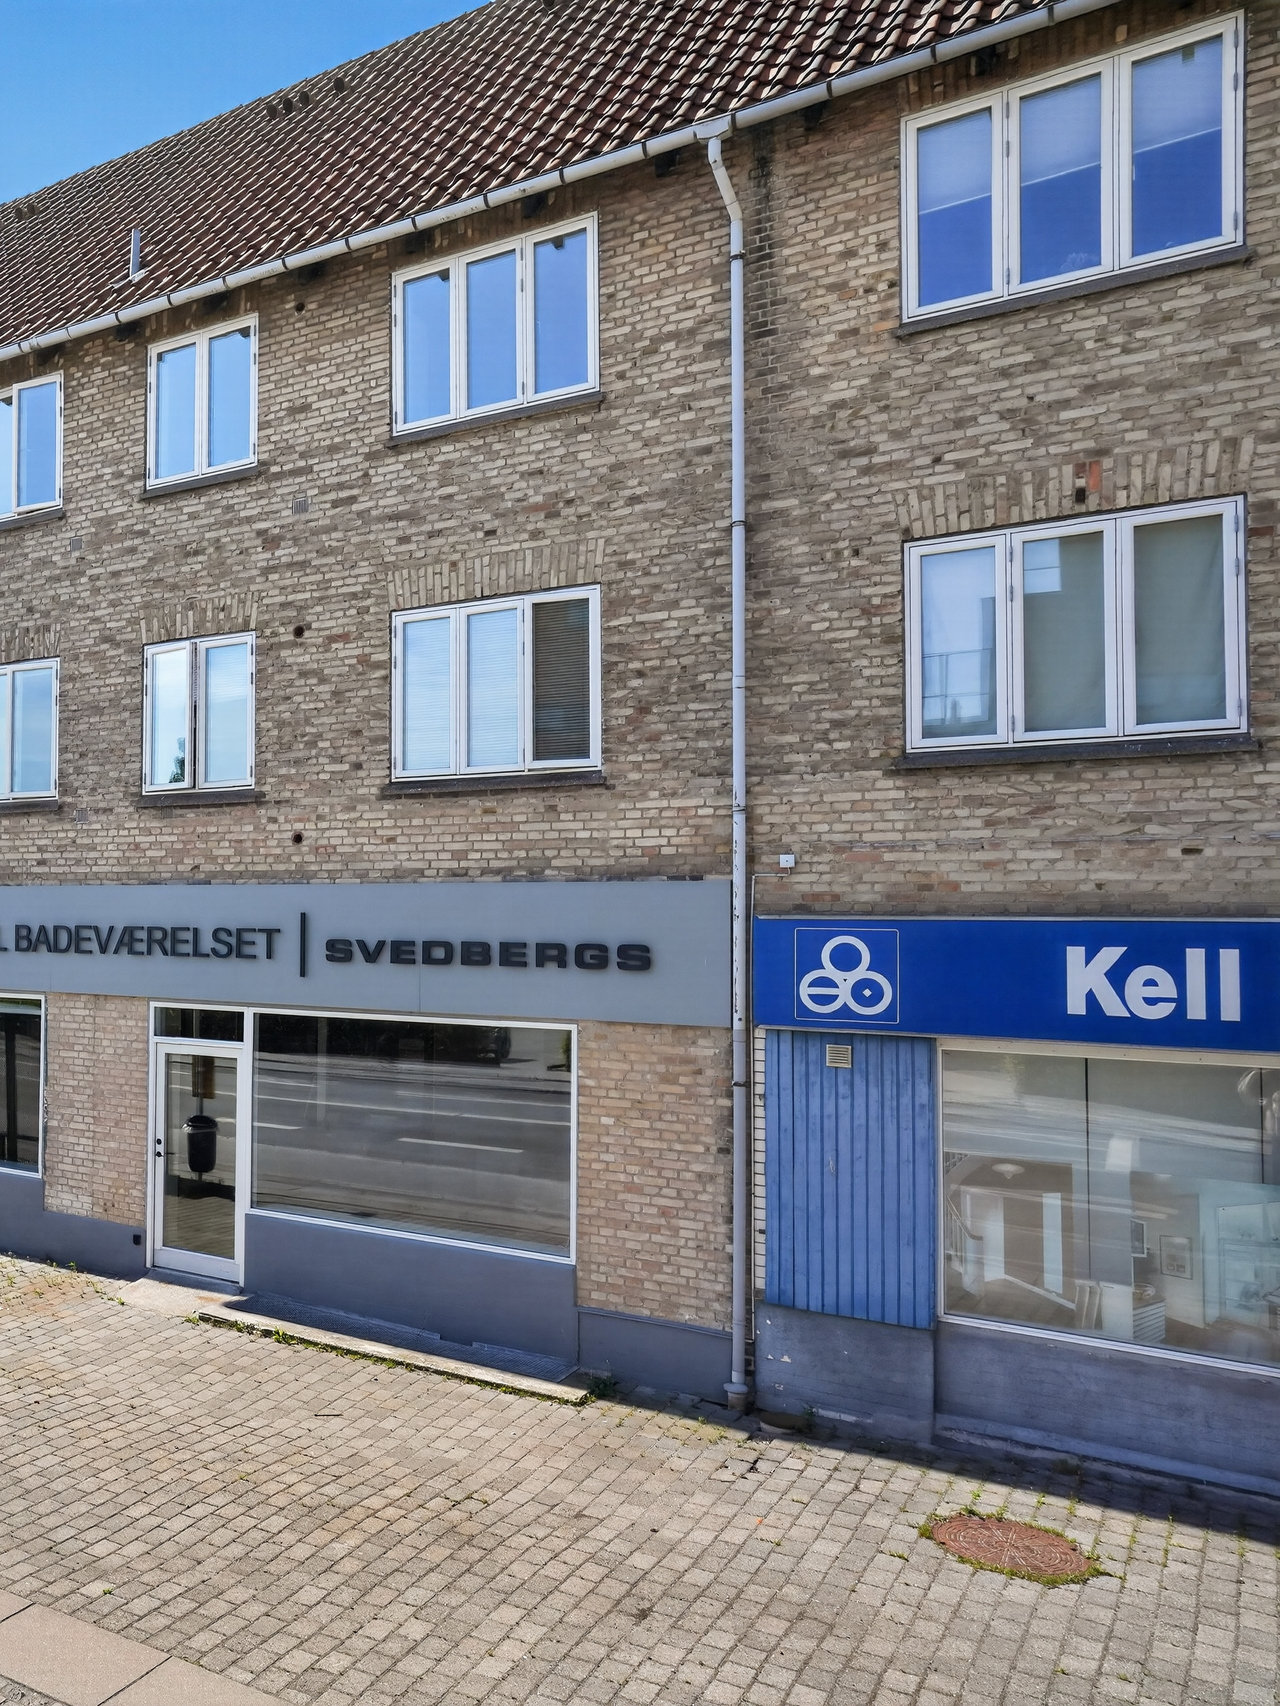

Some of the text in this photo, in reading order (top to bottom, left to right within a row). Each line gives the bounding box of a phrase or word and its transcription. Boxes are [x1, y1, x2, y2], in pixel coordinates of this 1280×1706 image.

[14, 924, 280, 960] BADEVÆRELSET
[325, 938, 653, 972] SVEDBERGS
[1066, 946, 1241, 1022] Kell
